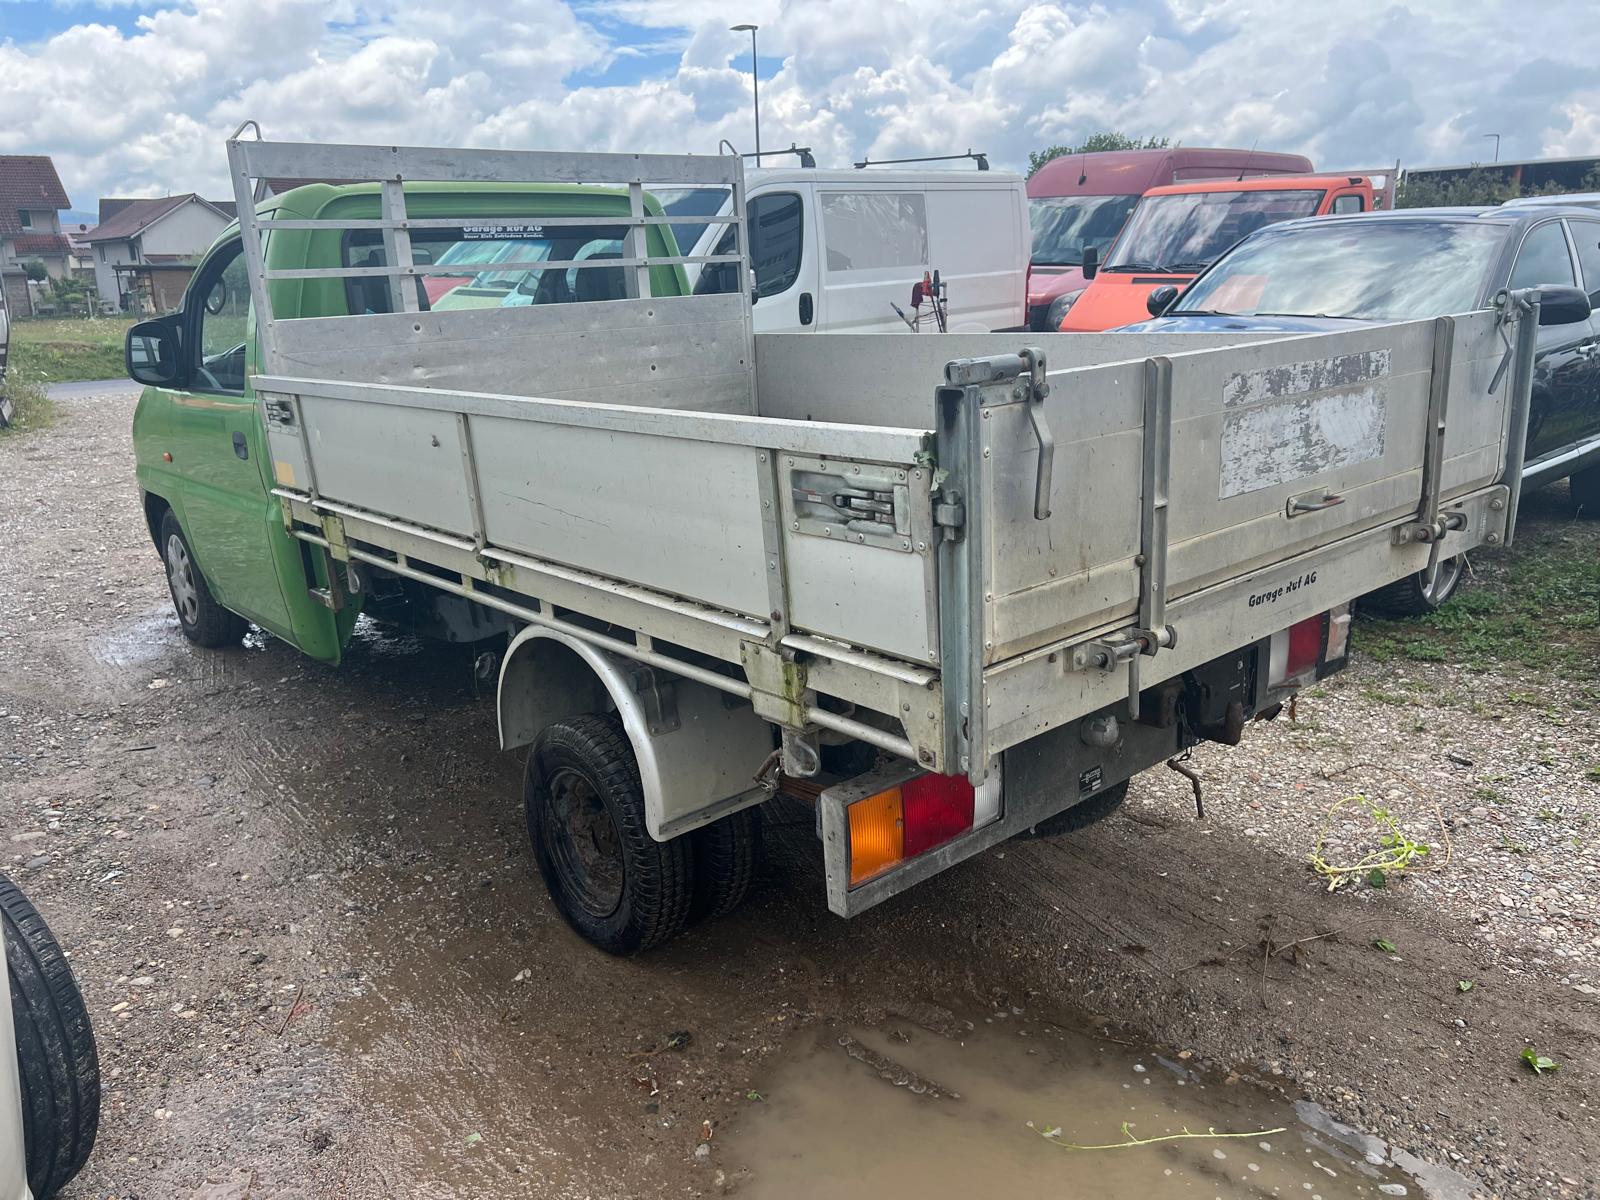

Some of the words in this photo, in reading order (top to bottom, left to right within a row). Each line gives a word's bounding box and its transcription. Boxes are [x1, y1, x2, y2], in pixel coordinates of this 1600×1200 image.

[463, 225, 503, 234] Garage
[1248, 587, 1283, 608] Garage
[1286, 576, 1302, 594] Ruf
[1304, 571, 1317, 586] AG
